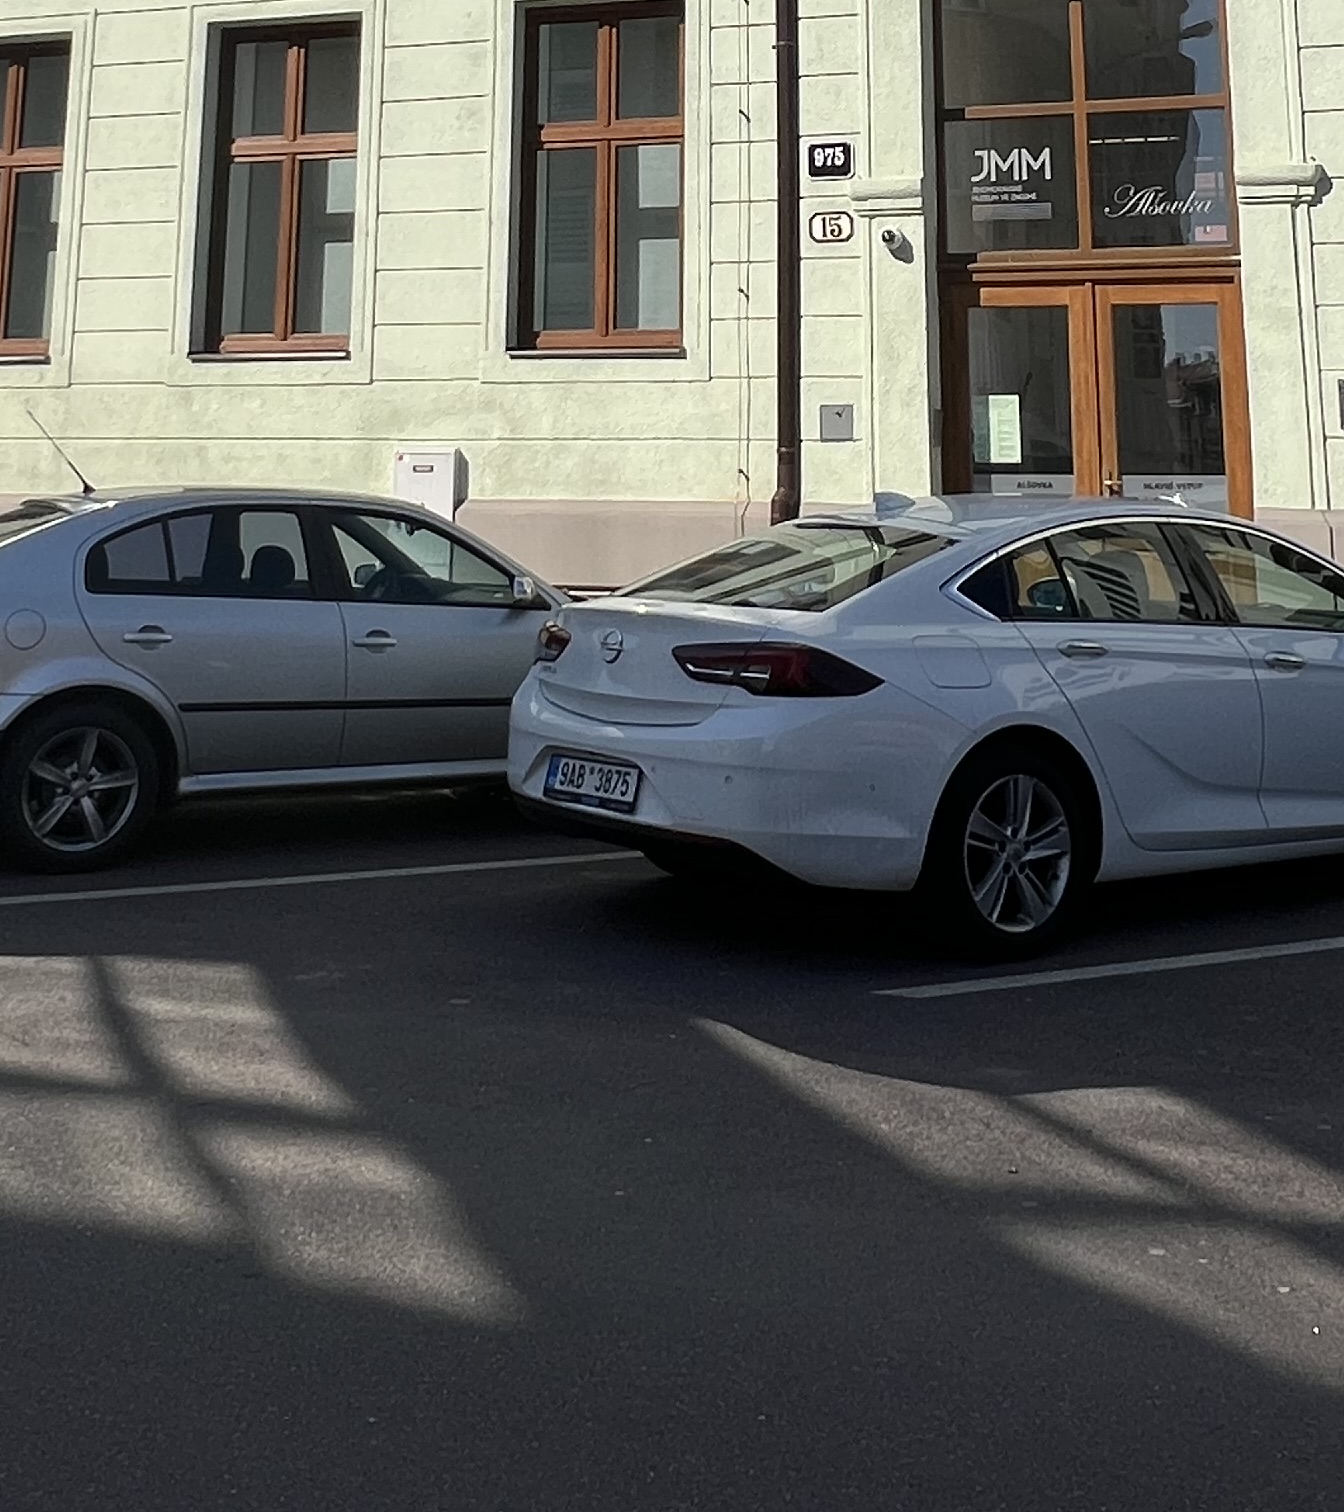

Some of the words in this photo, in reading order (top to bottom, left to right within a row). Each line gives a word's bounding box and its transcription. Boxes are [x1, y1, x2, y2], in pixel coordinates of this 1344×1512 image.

[814, 146, 845, 167] 975
[971, 147, 1052, 182] JMM
[1104, 184, 1212, 218] Alšovka
[821, 215, 843, 238] 15
[558, 761, 586, 790] 9AB
[595, 768, 632, 798] 3875
